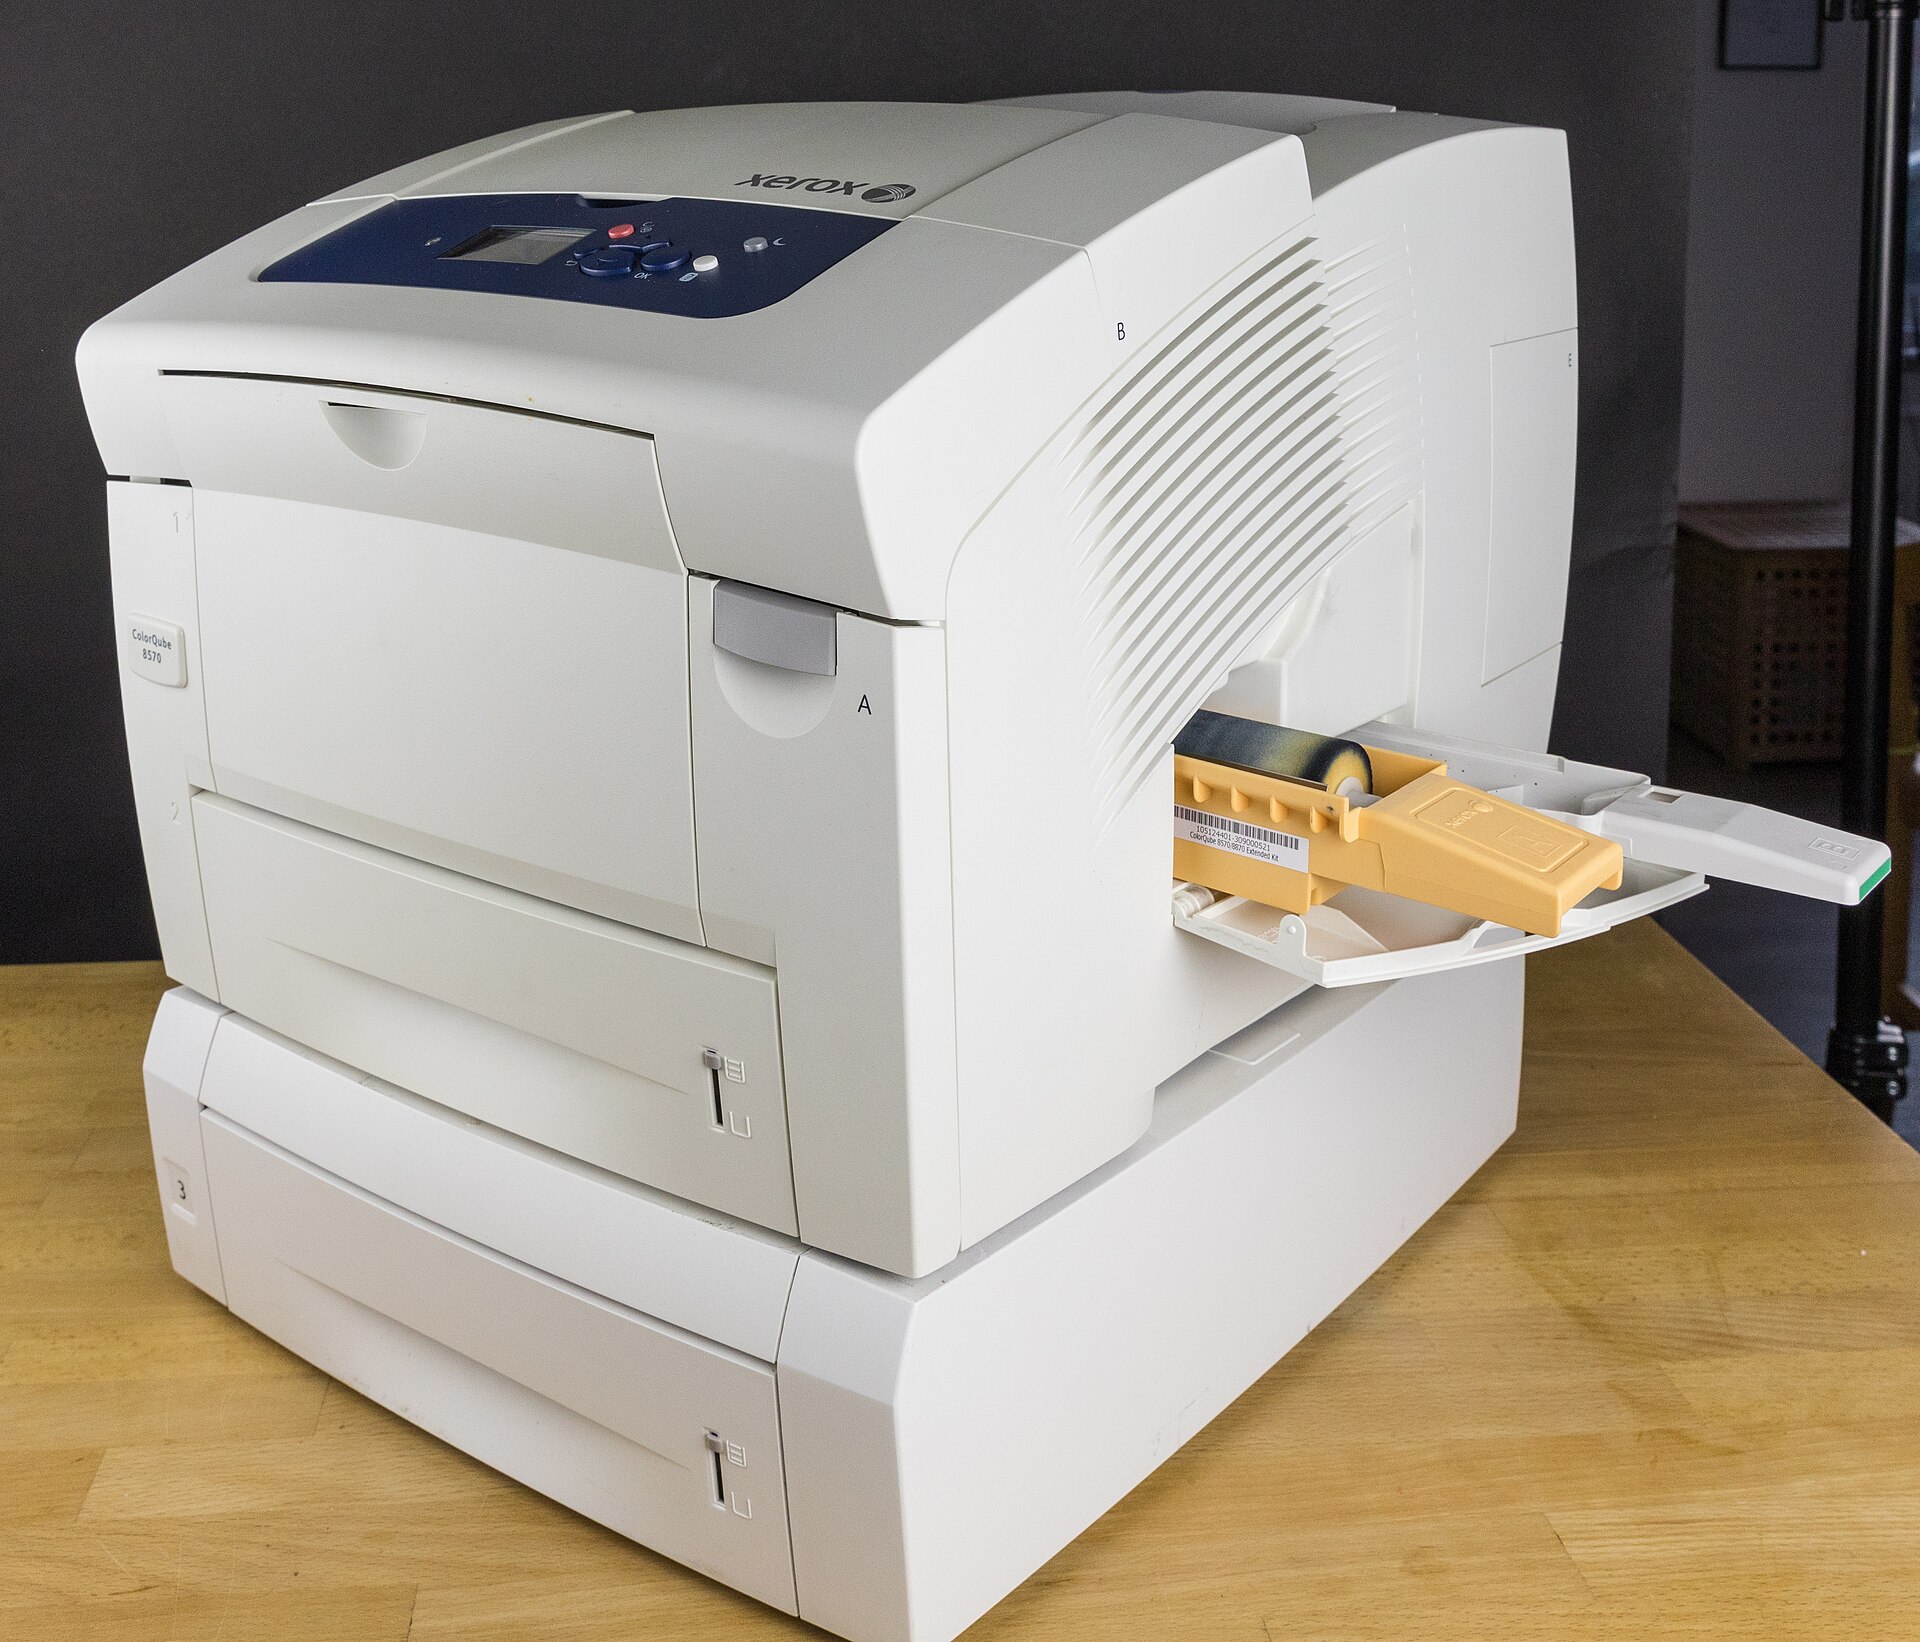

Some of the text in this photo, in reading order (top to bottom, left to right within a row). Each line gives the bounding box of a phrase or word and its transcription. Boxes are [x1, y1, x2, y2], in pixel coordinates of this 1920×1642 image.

[734, 174, 870, 195] xerox
[1117, 322, 1126, 341] B
[132, 629, 171, 650] ColorQube
[142, 648, 162, 664] 8570
[858, 694, 872, 715] A
[1189, 830, 1279, 863] ColorQube 8570/8870 Extended Kit
[1196, 825, 1270, 852] 105124401-309000521
[177, 1180, 186, 1200] 3
